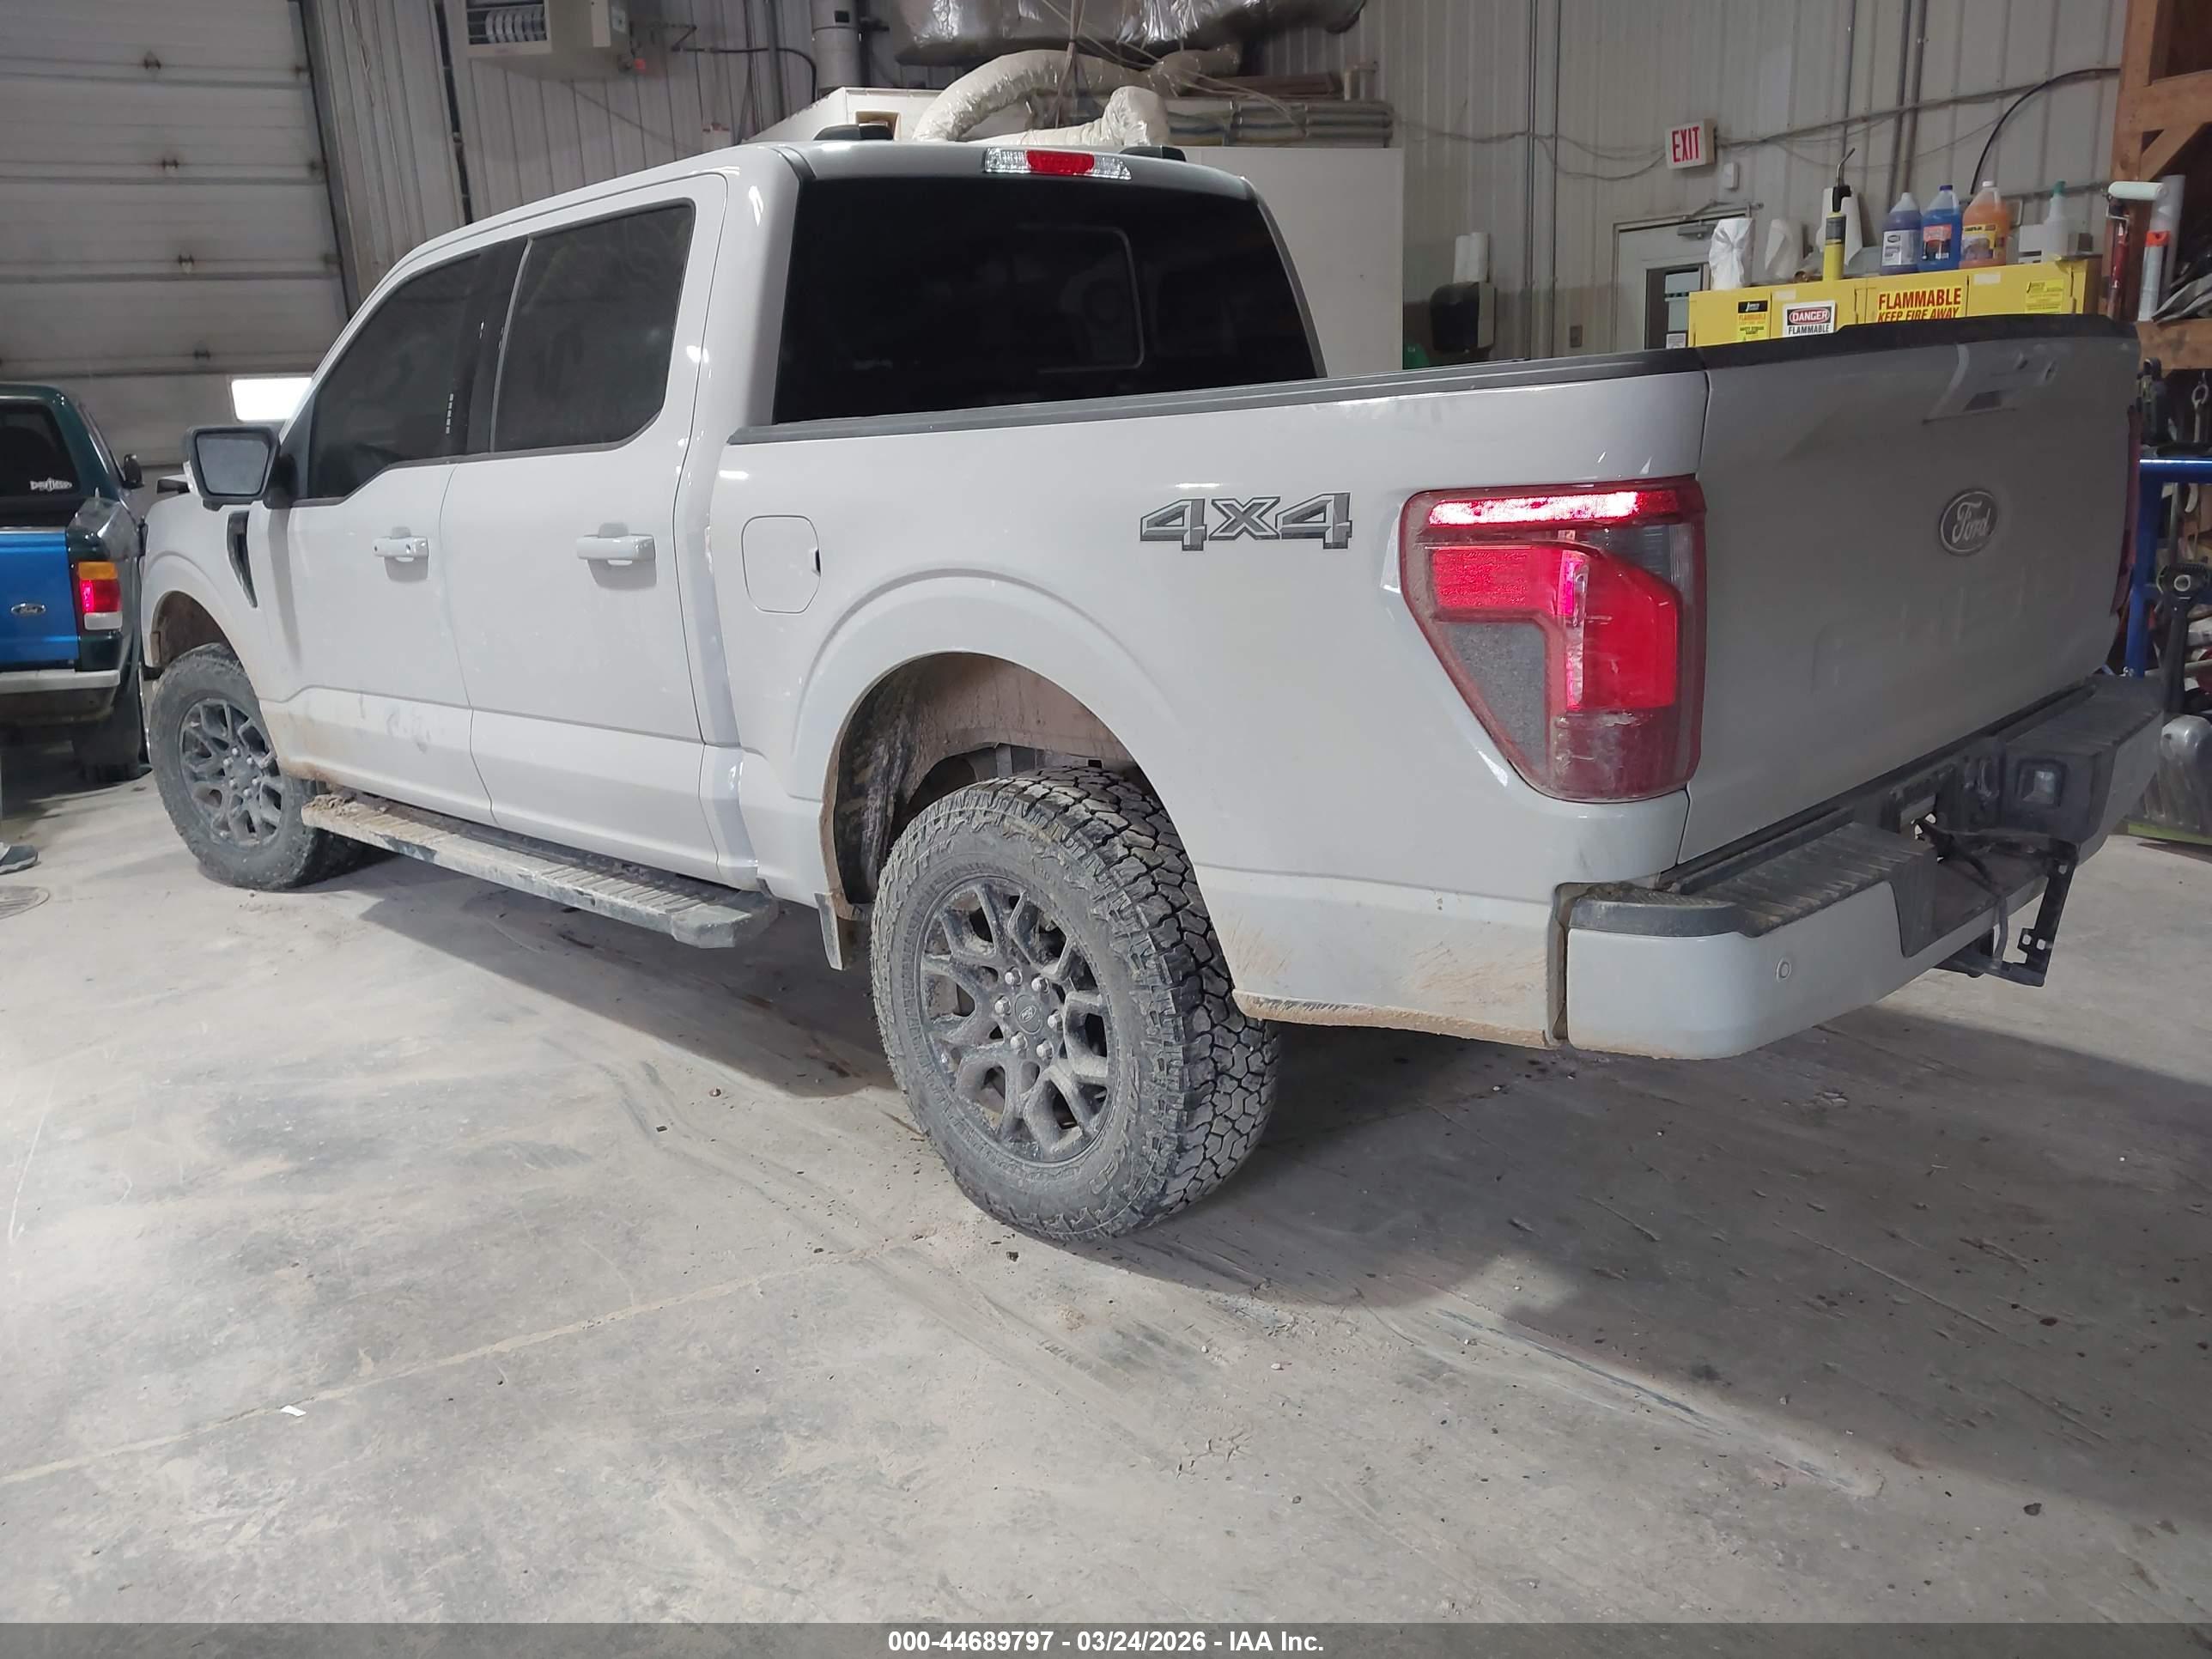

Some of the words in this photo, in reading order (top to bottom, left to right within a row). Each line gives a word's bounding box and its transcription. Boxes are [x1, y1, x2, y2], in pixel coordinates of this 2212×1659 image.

[1672, 126, 1699, 162] EXIT
[1878, 288, 1961, 310] FLAMMABLE
[1792, 310, 1828, 322] DANGER
[1877, 310, 1903, 323] KEEP
[1905, 308, 1929, 321] FIRE
[1929, 307, 1959, 319] AWAY
[1788, 325, 1830, 335] FLAMMABLE
[1952, 501, 1991, 544] Ford
